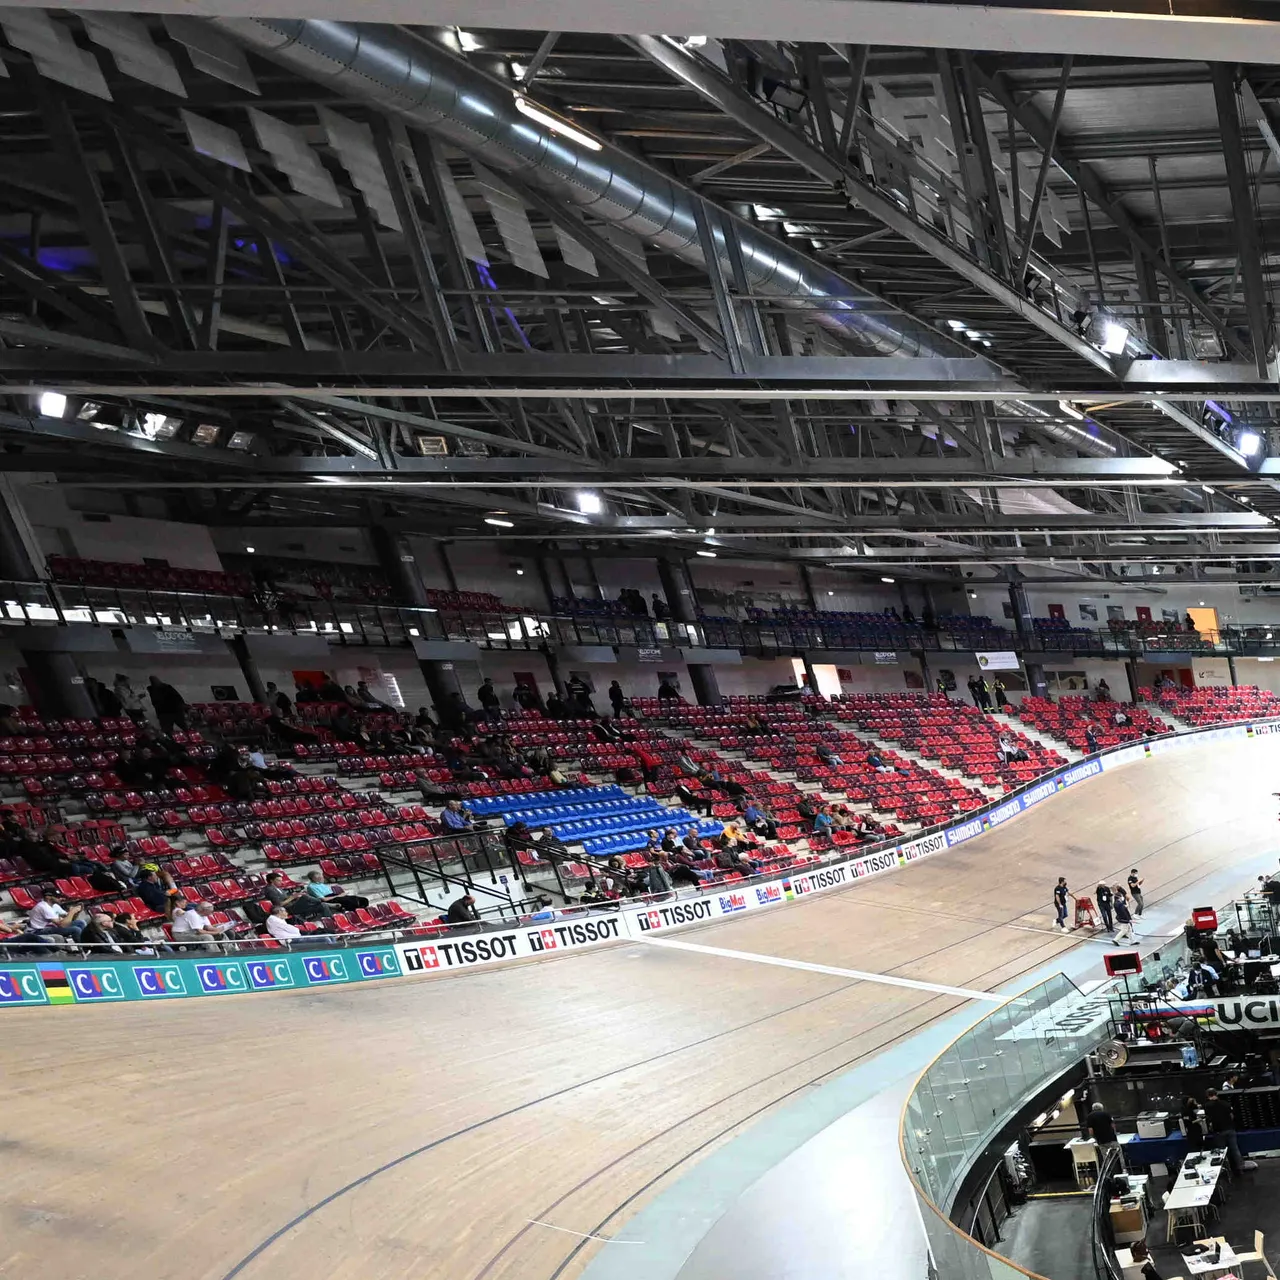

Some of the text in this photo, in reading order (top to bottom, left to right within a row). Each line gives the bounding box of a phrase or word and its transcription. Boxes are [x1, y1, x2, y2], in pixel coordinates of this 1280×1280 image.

[1064, 762, 1100, 786] SHIMANO
[1023, 780, 1056, 806] SHIMANO
[989, 800, 1021, 827] SHIMANO
[948, 819, 982, 845] SHIMANO
[916, 835, 944, 856] TISSOT
[863, 852, 896, 874] TISSOT
[808, 867, 845, 891] TISSOT
[719, 894, 747, 912] BigMat
[756, 887, 782, 905] BigMat
[660, 900, 713, 926] TISSOT
[560, 918, 620, 948] TISSOT
[437, 935, 518, 967] TISSOT
[250, 964, 290, 986] CIC
[308, 959, 345, 980] CIC
[361, 954, 396, 973] CIC
[75, 972, 118, 994] CIC
[141, 970, 181, 992] CIC
[203, 967, 244, 990] CIC
[1217, 1000, 1278, 1024] UCI
